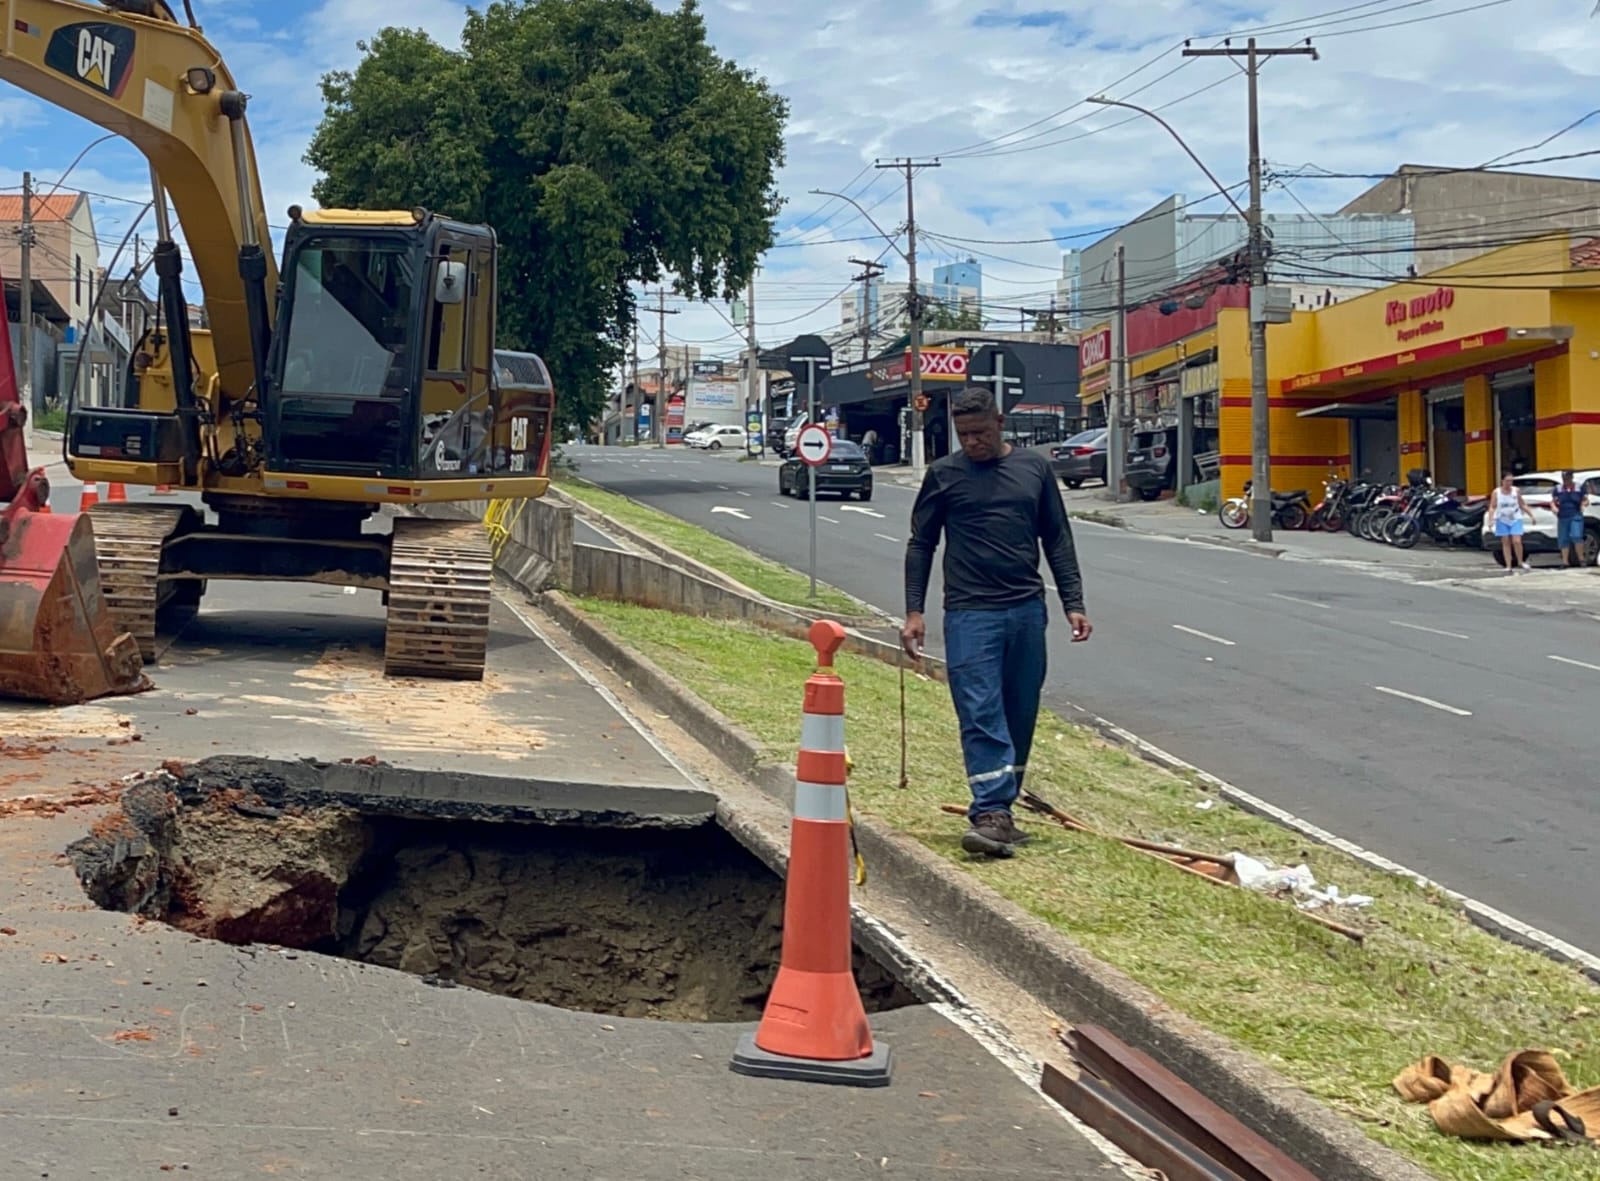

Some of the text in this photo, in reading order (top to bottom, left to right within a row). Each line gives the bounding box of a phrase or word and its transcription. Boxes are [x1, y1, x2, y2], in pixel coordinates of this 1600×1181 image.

[77, 28, 115, 90] CAT
[1386, 287, 1454, 326] Ka moto
[1083, 333, 1105, 367] OXXO
[511, 417, 528, 451] CAT
